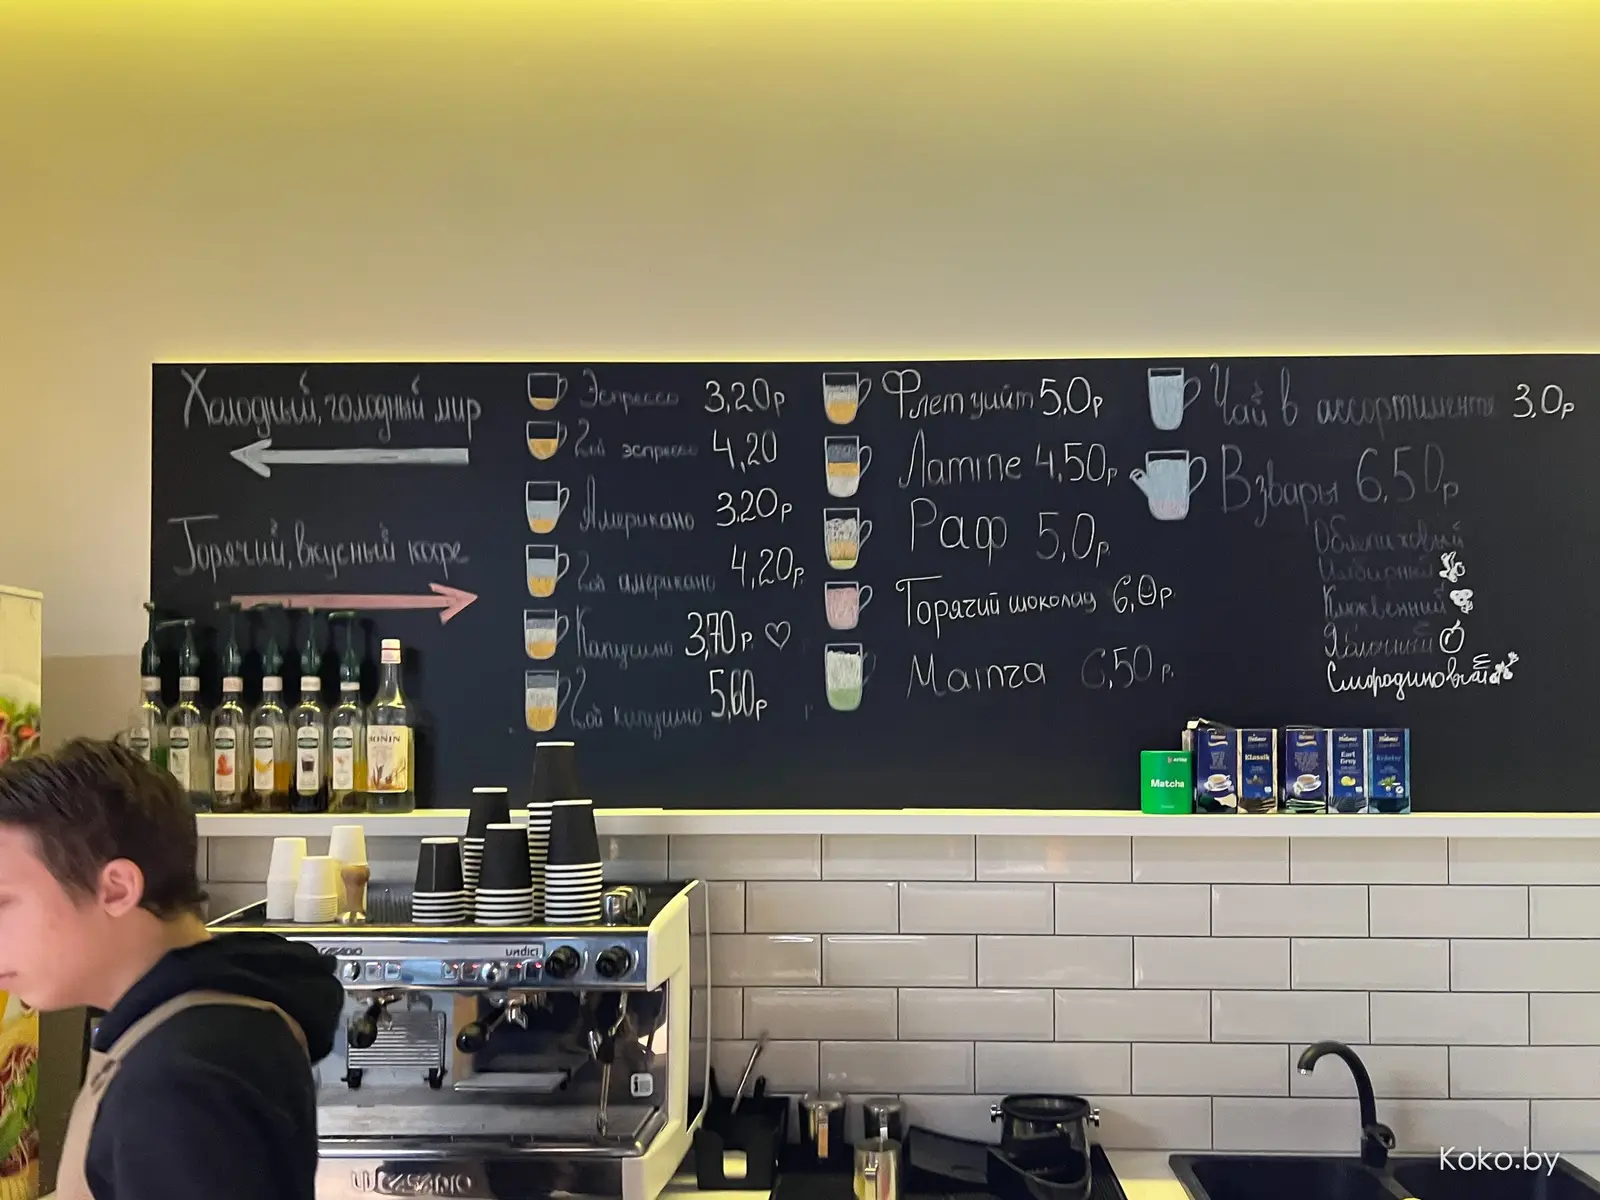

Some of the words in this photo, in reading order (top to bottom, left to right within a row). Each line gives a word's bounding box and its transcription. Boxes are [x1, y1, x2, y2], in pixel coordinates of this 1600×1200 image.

[704, 377, 785, 417] 3,20р
[881, 369, 964, 420] Флет
[1039, 376, 1103, 418] 5,0р
[1210, 362, 1268, 427] Чай
[1281, 366, 1298, 427] в
[1512, 383, 1575, 420] 3,0р
[434, 398, 482, 441] мир
[712, 429, 777, 473] 4,20
[1035, 442, 1118, 487] 4,50р
[579, 474, 695, 540] Американо
[1221, 444, 1338, 528] Взвары
[294, 520, 397, 579] вкусный
[408, 540, 470, 580] кофе
[910, 498, 1007, 567] Раф
[618, 572, 717, 602] американо
[895, 575, 1001, 639] Горячий
[1008, 591, 1097, 614] шоколад
[1245, 753, 1270, 761] Klassik
[1150, 778, 1185, 788] Matcha
[505, 946, 539, 957] undici
